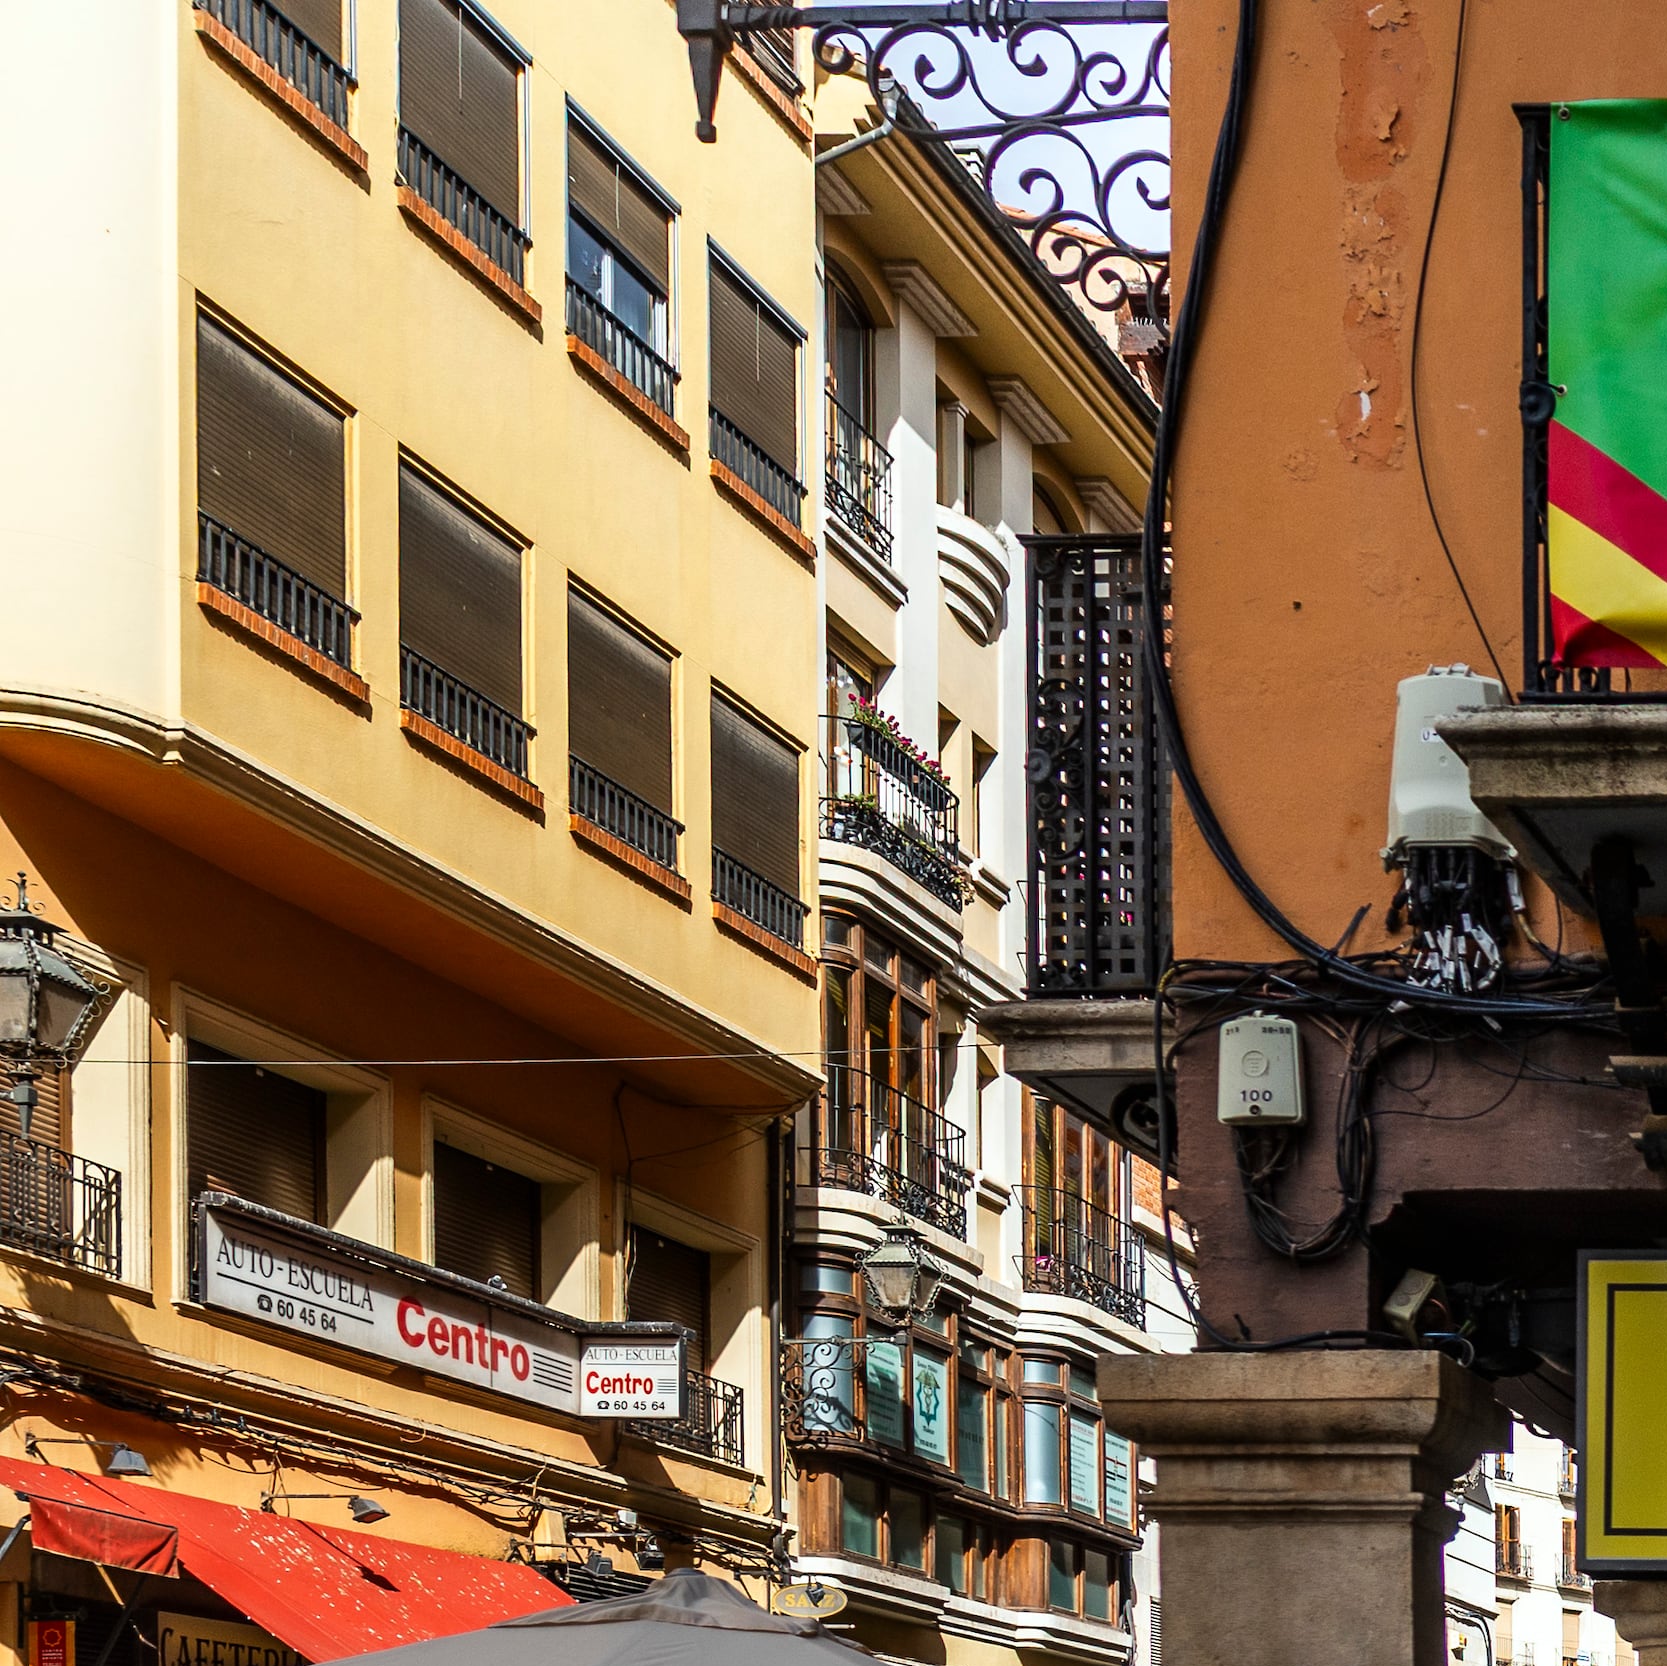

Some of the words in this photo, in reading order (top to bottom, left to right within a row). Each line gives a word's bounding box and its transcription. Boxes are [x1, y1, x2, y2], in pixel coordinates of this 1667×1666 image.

[1240, 1089, 1273, 1102] 100
[277, 1299, 294, 1320] 60
[299, 1306, 315, 1327] 45
[320, 1312, 337, 1333] 64
[396, 1295, 530, 1381] Centro
[585, 1370, 654, 1395] Centro
[613, 1400, 628, 1411] 60
[633, 1400, 647, 1411] 45
[651, 1400, 666, 1411] 64
[785, 1592, 834, 1607] SAZ
